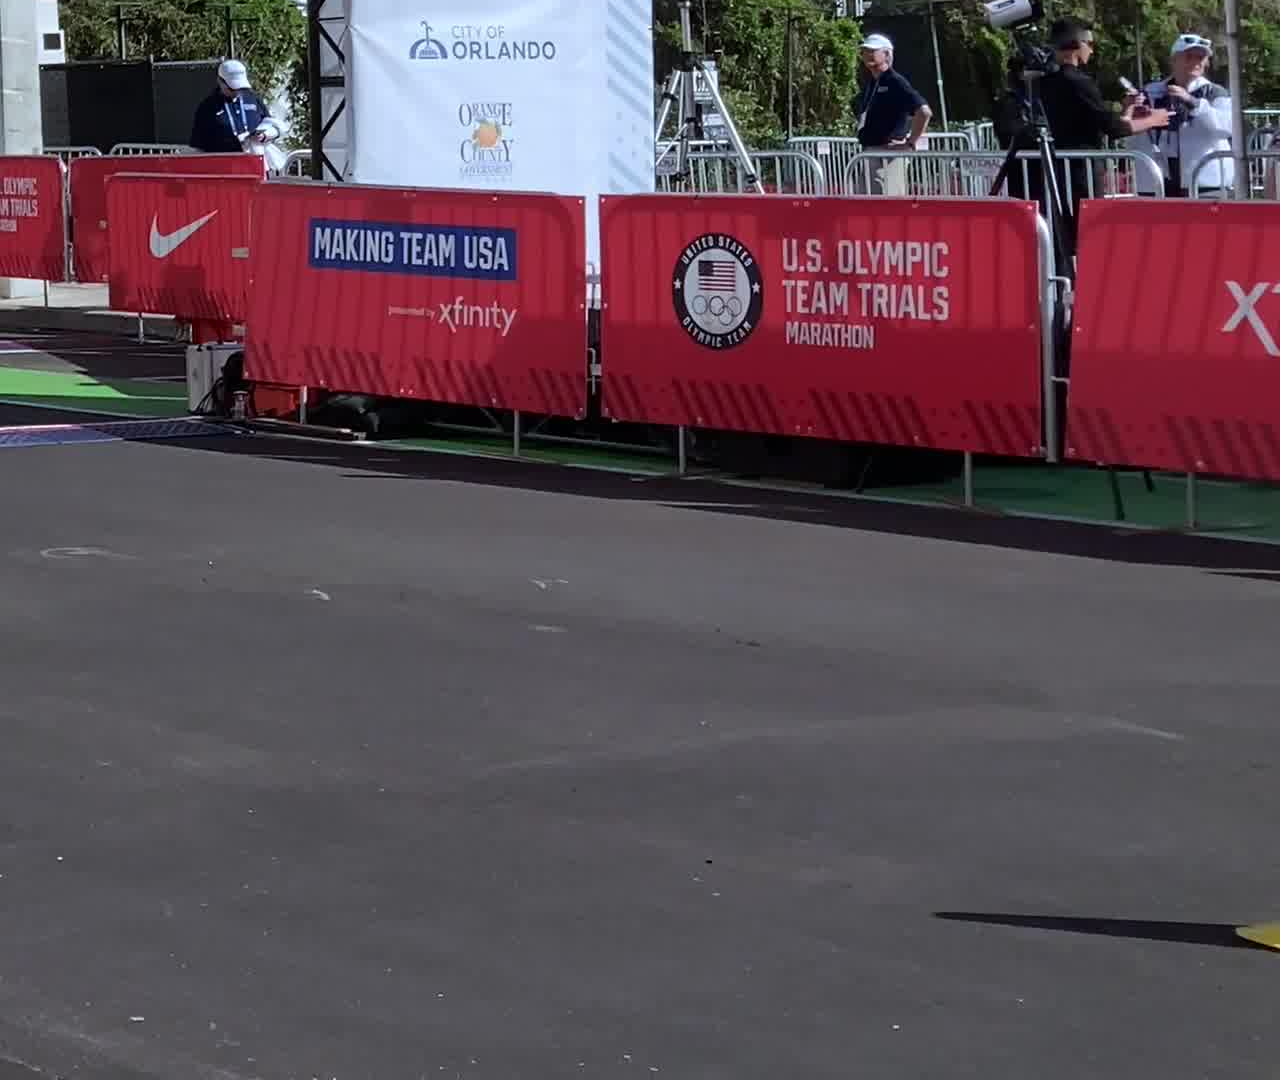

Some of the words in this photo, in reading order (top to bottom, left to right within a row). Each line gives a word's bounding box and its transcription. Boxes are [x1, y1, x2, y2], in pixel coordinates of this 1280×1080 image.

[451, 24, 484, 39] CITY
[487, 25, 505, 39] OF
[452, 41, 556, 60] ORLANDO
[458, 103, 513, 127] ORANGE
[4, 177, 37, 196] OLYMPIC
[10, 198, 38, 217] TRIALS
[314, 226, 394, 264] MAKING
[400, 232, 456, 269] TEAM
[464, 235, 510, 271] USA
[680, 235, 715, 266] UNITED
[782, 238, 829, 274] U.S.
[838, 239, 949, 279] OLYMPIC
[782, 279, 849, 316] TEAM
[858, 281, 949, 321] TRIALS
[438, 295, 518, 337] xfinity
[785, 321, 875, 351] MARATHON
